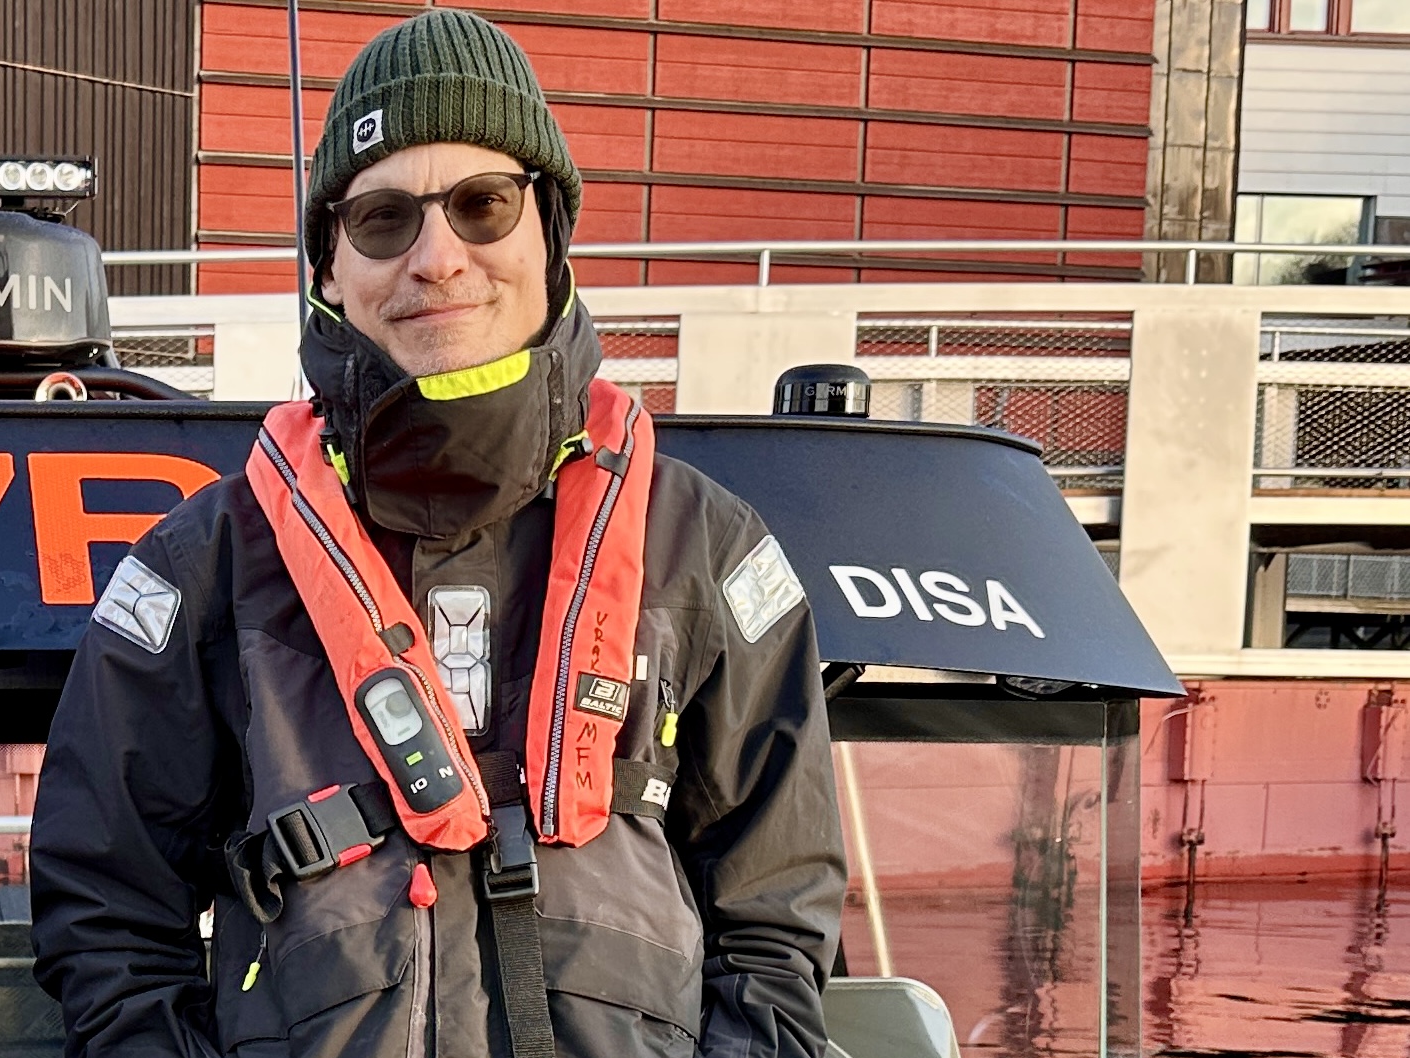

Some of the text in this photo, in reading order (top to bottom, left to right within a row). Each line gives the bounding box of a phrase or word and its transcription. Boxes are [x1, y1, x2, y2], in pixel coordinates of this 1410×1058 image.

[828, 565, 1046, 639] DISA
[580, 697, 623, 714] BALTIC
[439, 765, 454, 779] N
